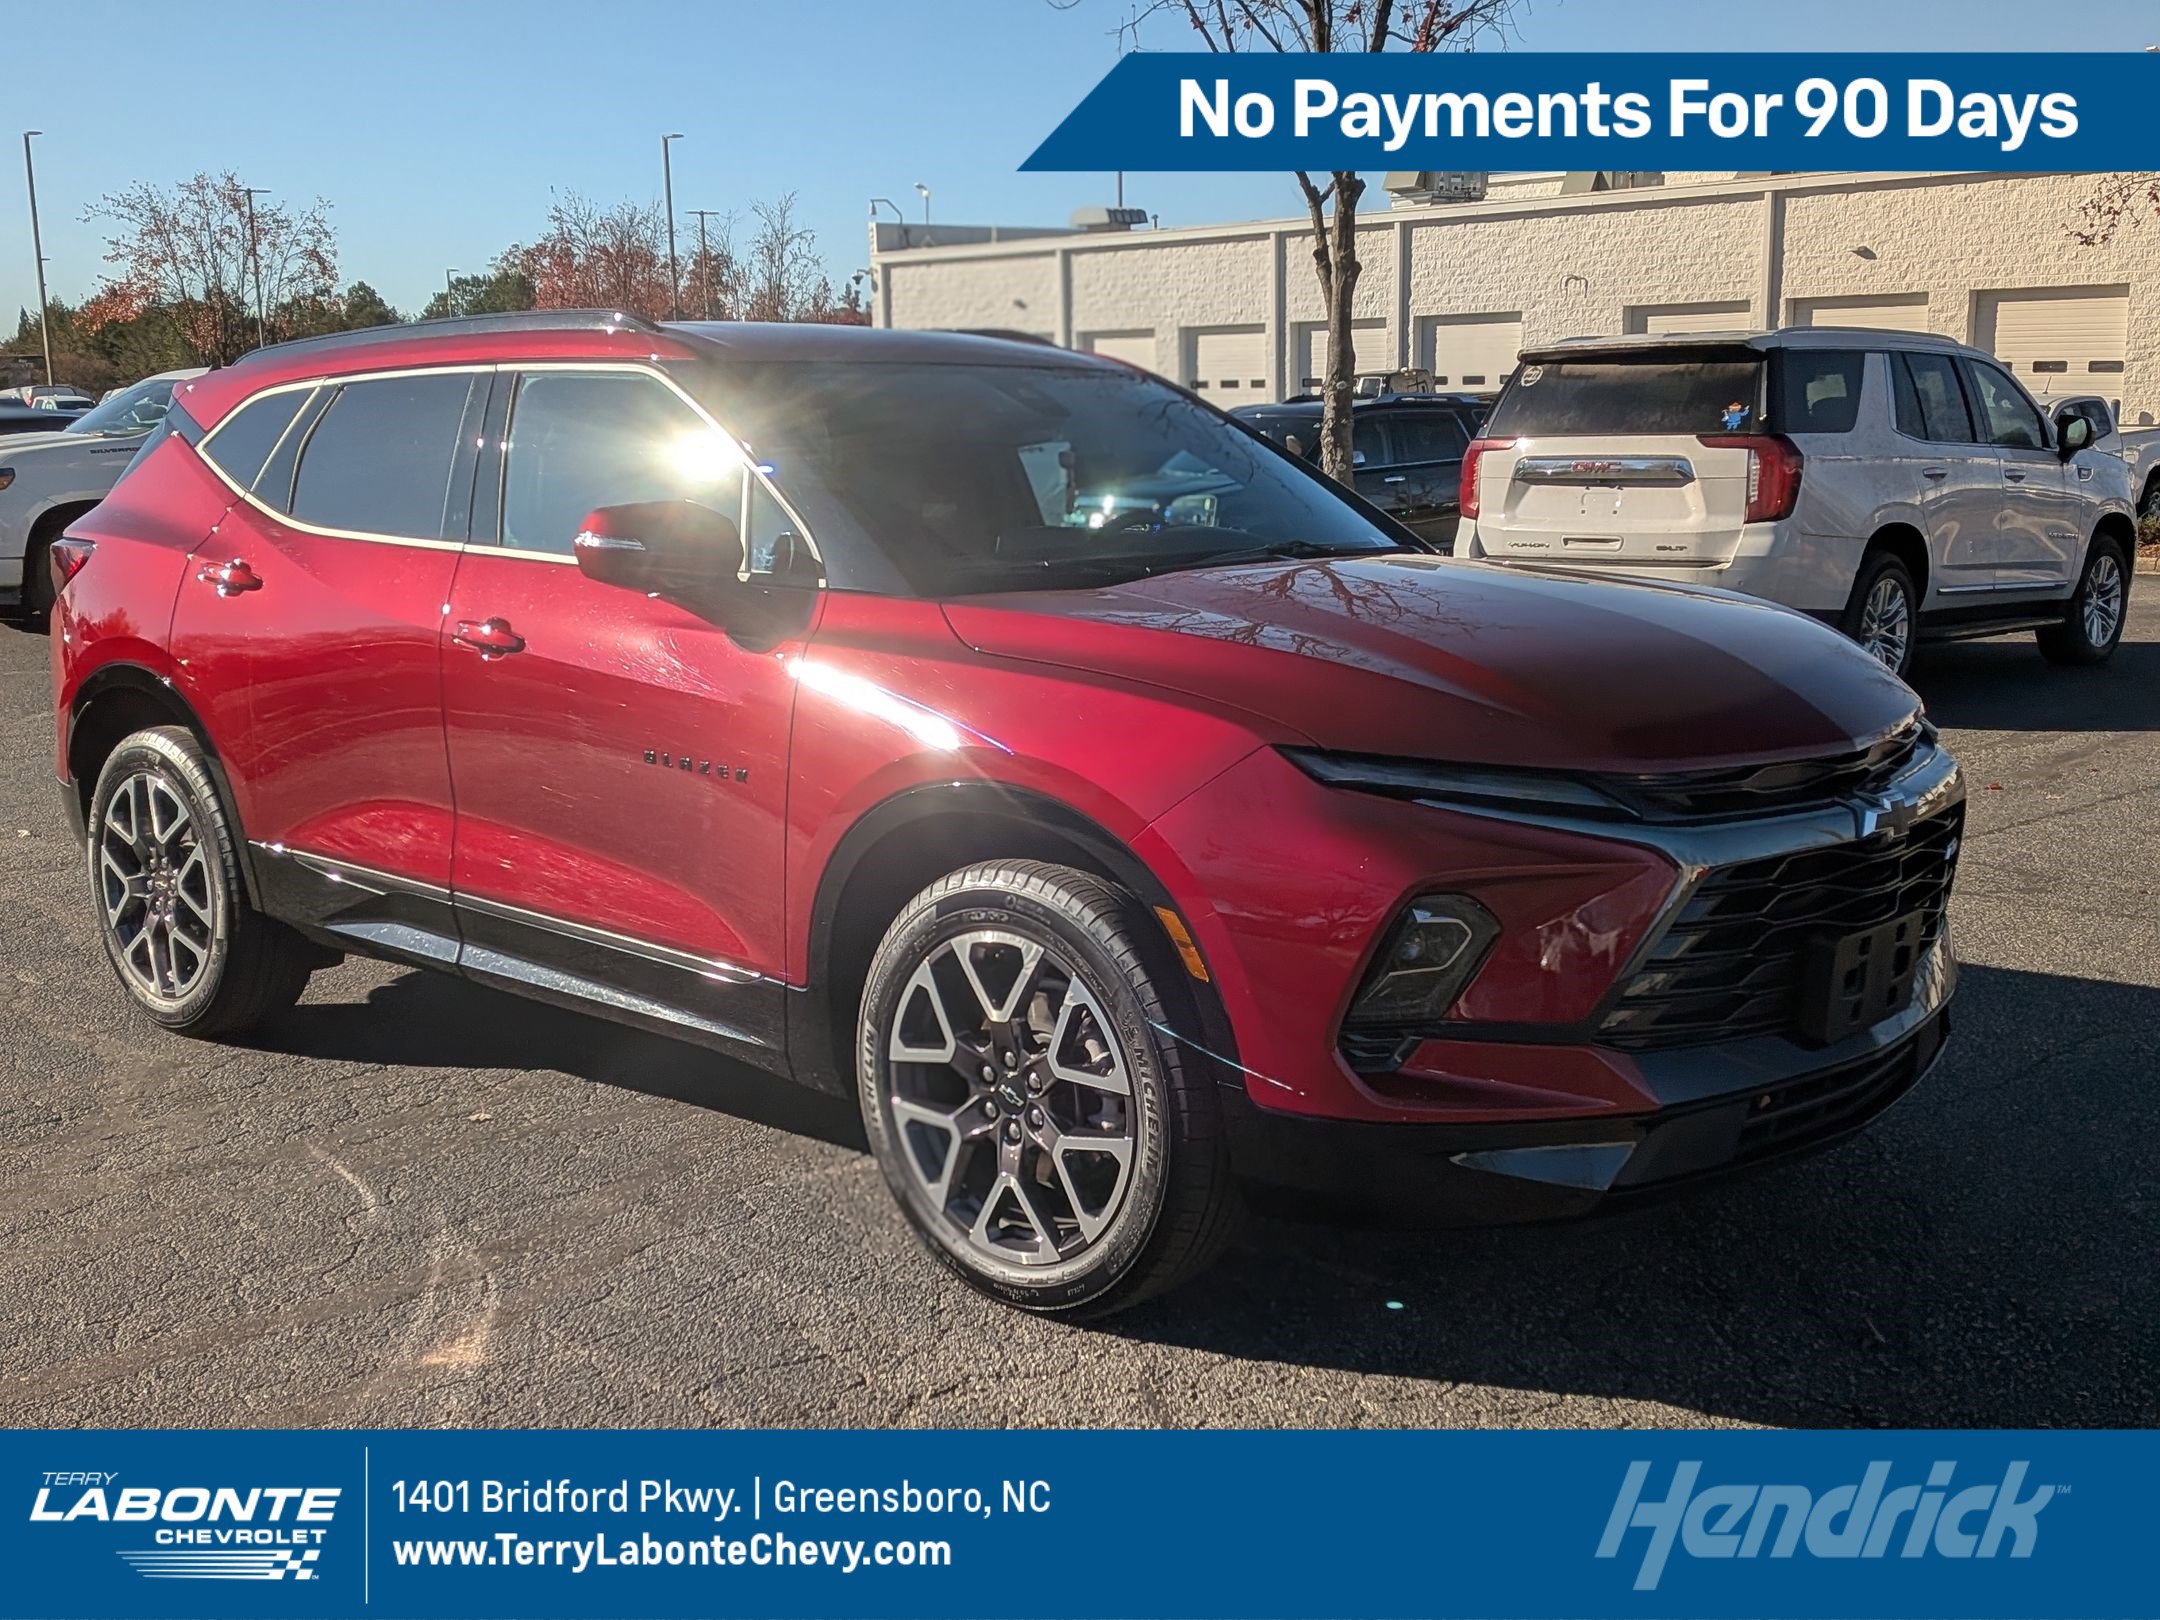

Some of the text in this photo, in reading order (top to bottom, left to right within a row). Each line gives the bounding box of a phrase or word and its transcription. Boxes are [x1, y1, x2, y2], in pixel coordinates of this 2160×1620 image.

[1571, 461, 1622, 473] GMC
[643, 749, 749, 784] BLAZER
[1133, 1047, 1160, 1176] MICHELIN
